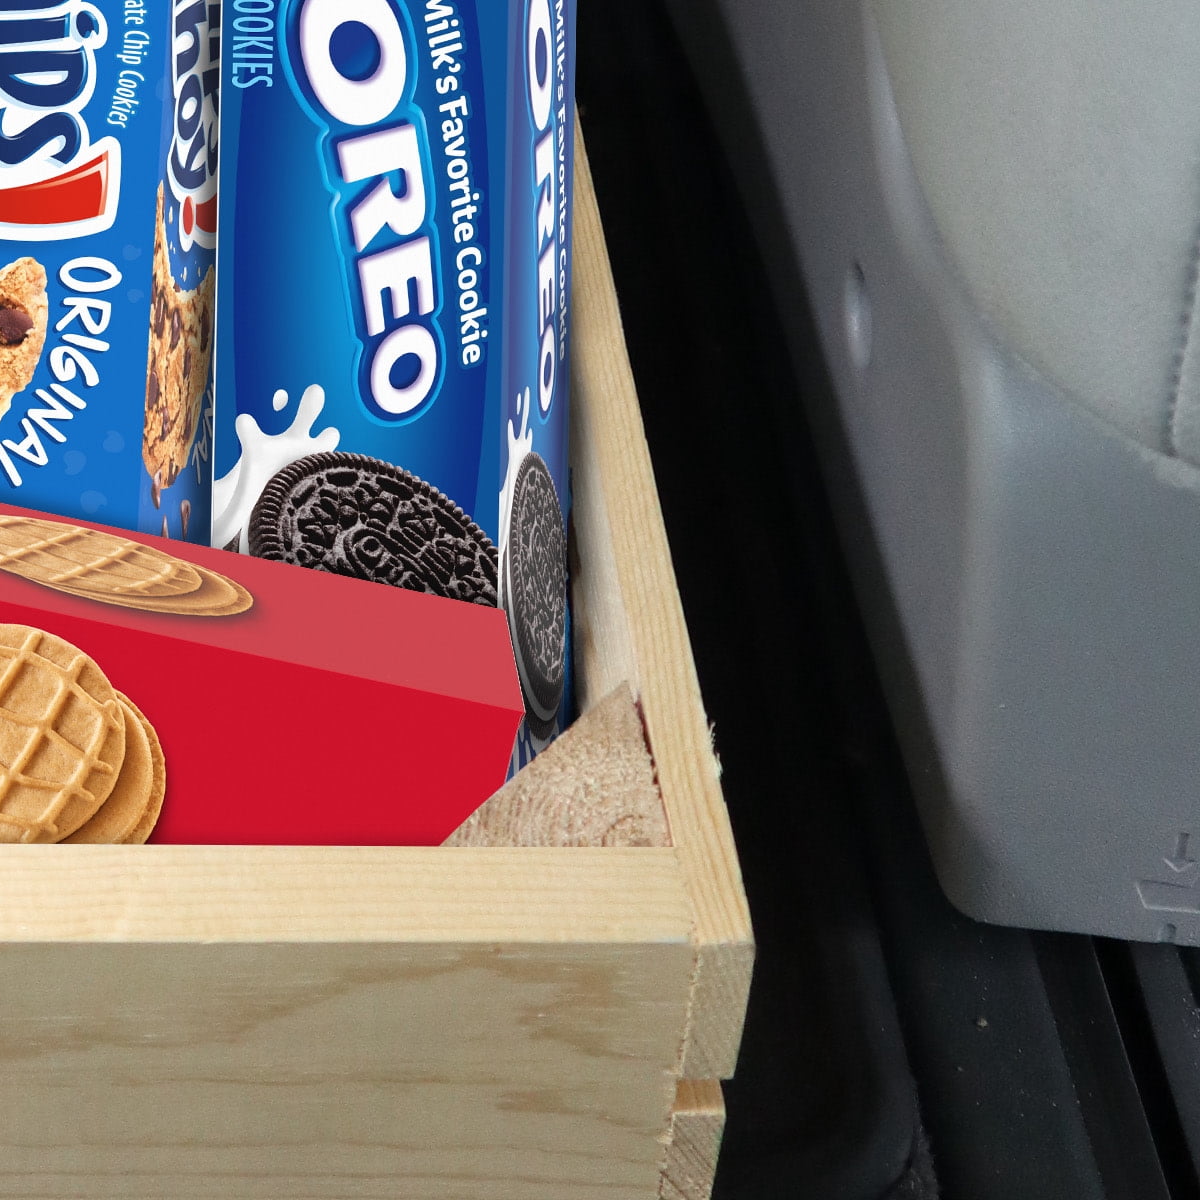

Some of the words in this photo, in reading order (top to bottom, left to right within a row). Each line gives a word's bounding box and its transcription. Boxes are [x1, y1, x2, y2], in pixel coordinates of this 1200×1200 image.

[107, 70, 146, 129] Cookies
[116, 29, 151, 67] Chip
[439, 94, 482, 242] Favorite
[557, 103, 568, 245] Favorite
[456, 246, 489, 366] Cookie
[559, 247, 568, 360] Cookie
